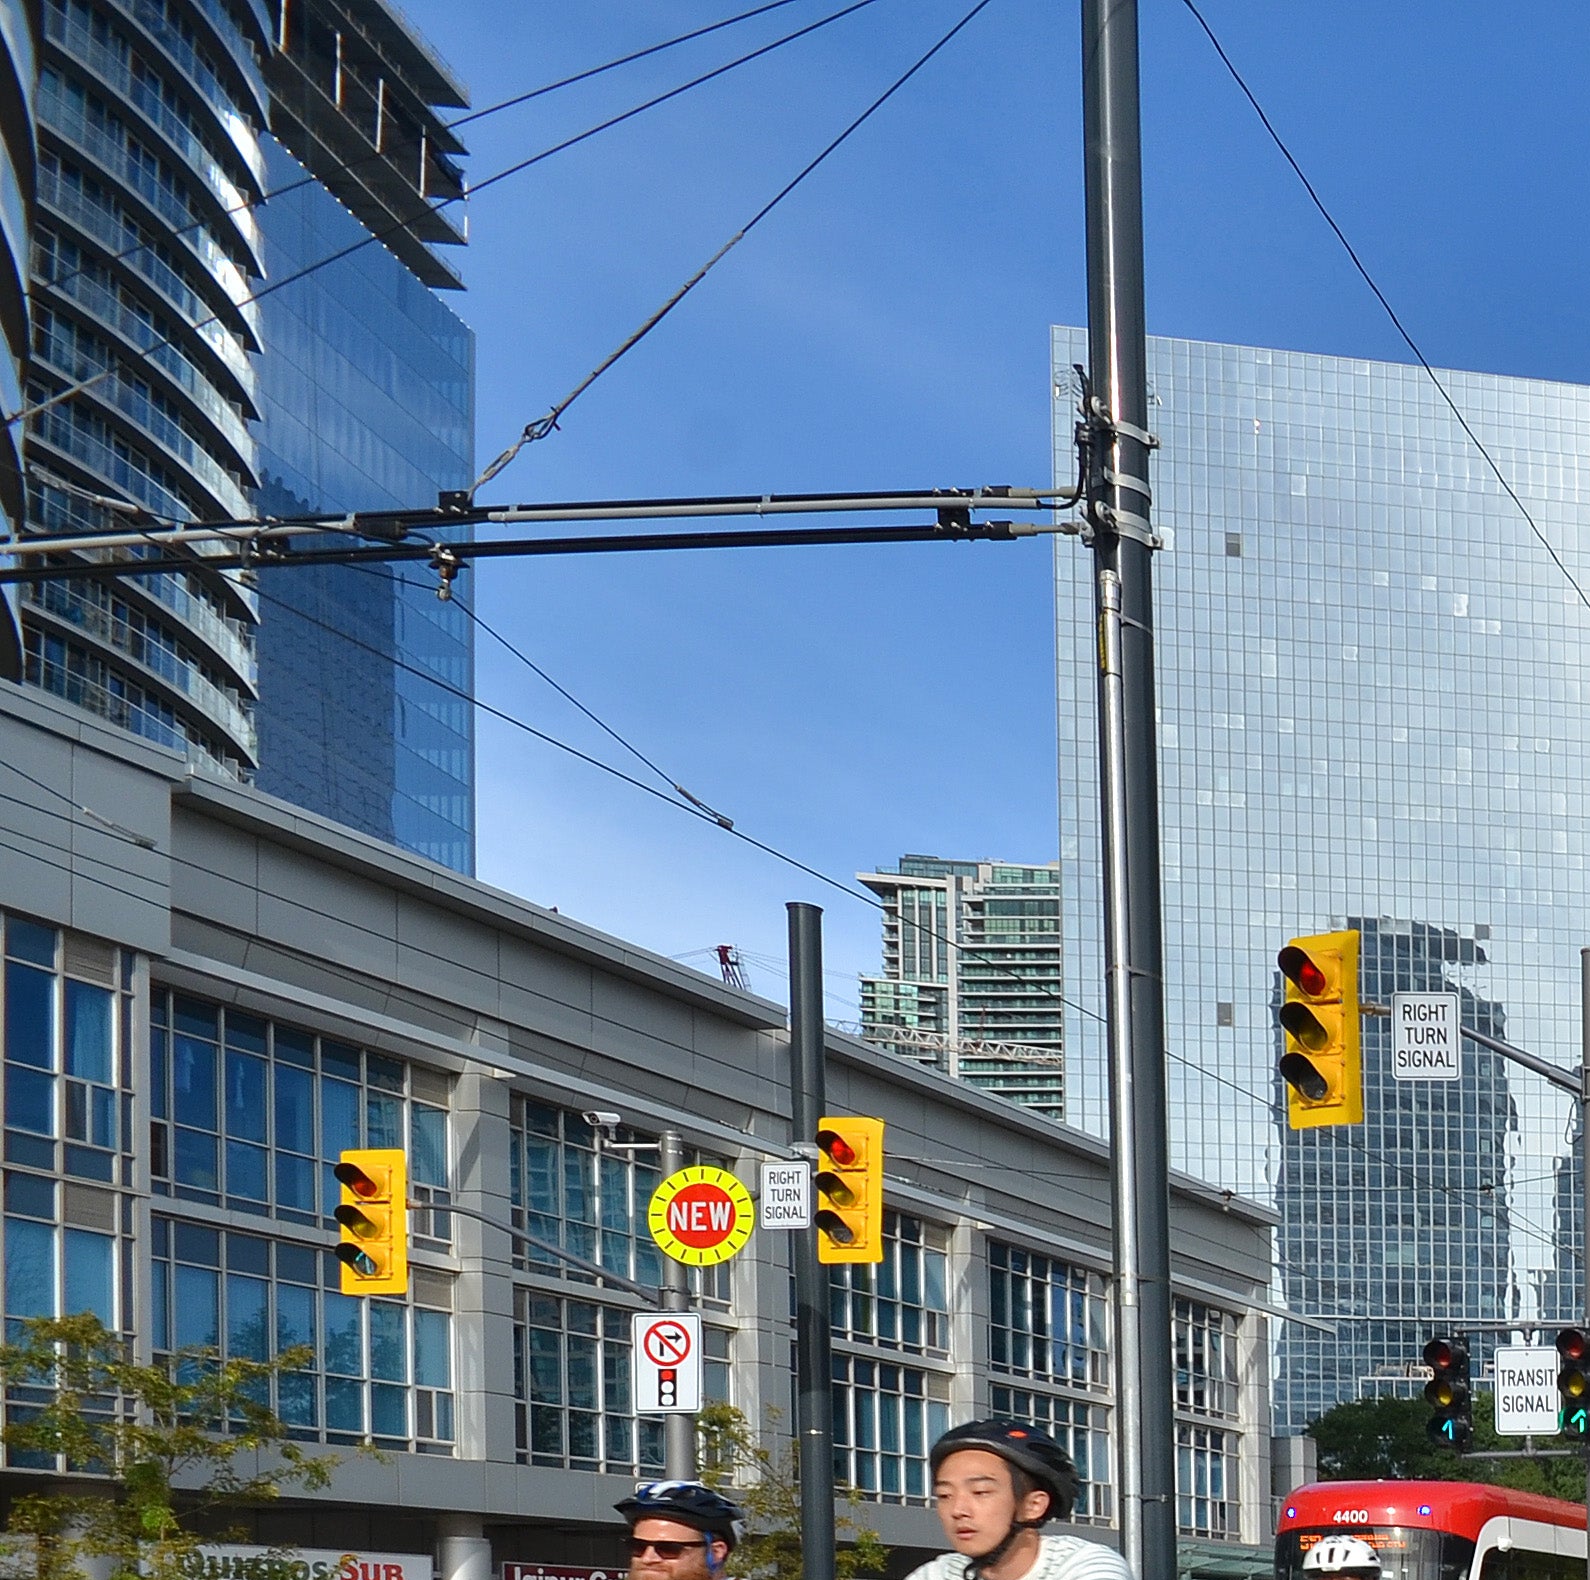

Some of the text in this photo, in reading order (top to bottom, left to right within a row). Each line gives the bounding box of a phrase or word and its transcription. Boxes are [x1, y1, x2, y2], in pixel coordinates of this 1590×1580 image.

[1402, 1004, 1448, 1021] RIGHT
[1405, 1027, 1447, 1044] TURN
[1398, 1050, 1455, 1067] SIGNAL
[769, 1171, 802, 1185] RIGHT
[771, 1189, 801, 1202] TURN
[670, 1201, 731, 1231] NEW
[765, 1206, 806, 1219] SIGNAL
[1500, 1369, 1555, 1386] TRANSIT
[1502, 1395, 1554, 1412] SIGNAL
[1333, 1510, 1369, 1523] 4400
